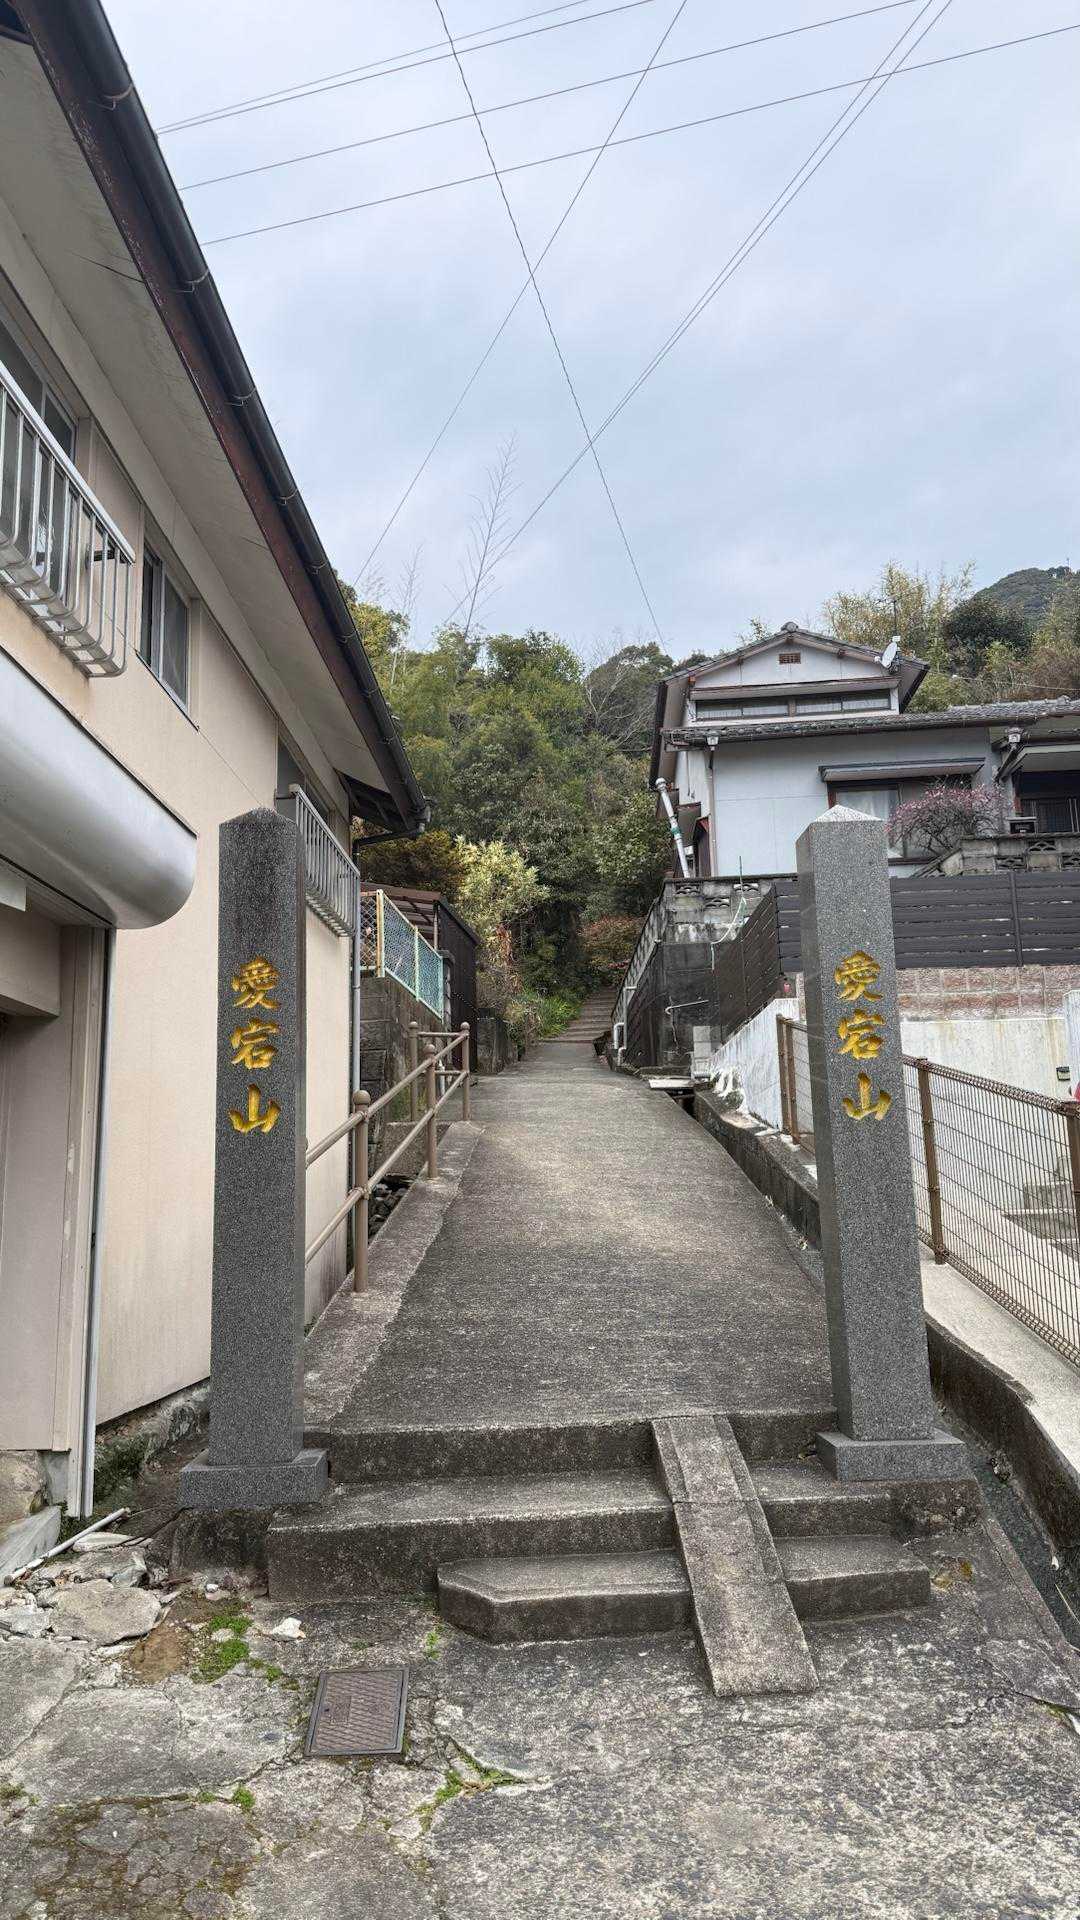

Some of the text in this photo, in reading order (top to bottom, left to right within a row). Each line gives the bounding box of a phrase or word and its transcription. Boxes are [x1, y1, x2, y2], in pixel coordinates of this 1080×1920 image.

[229, 956, 281, 1133] 愛宕山
[834, 950, 891, 1120] 愛宕山
